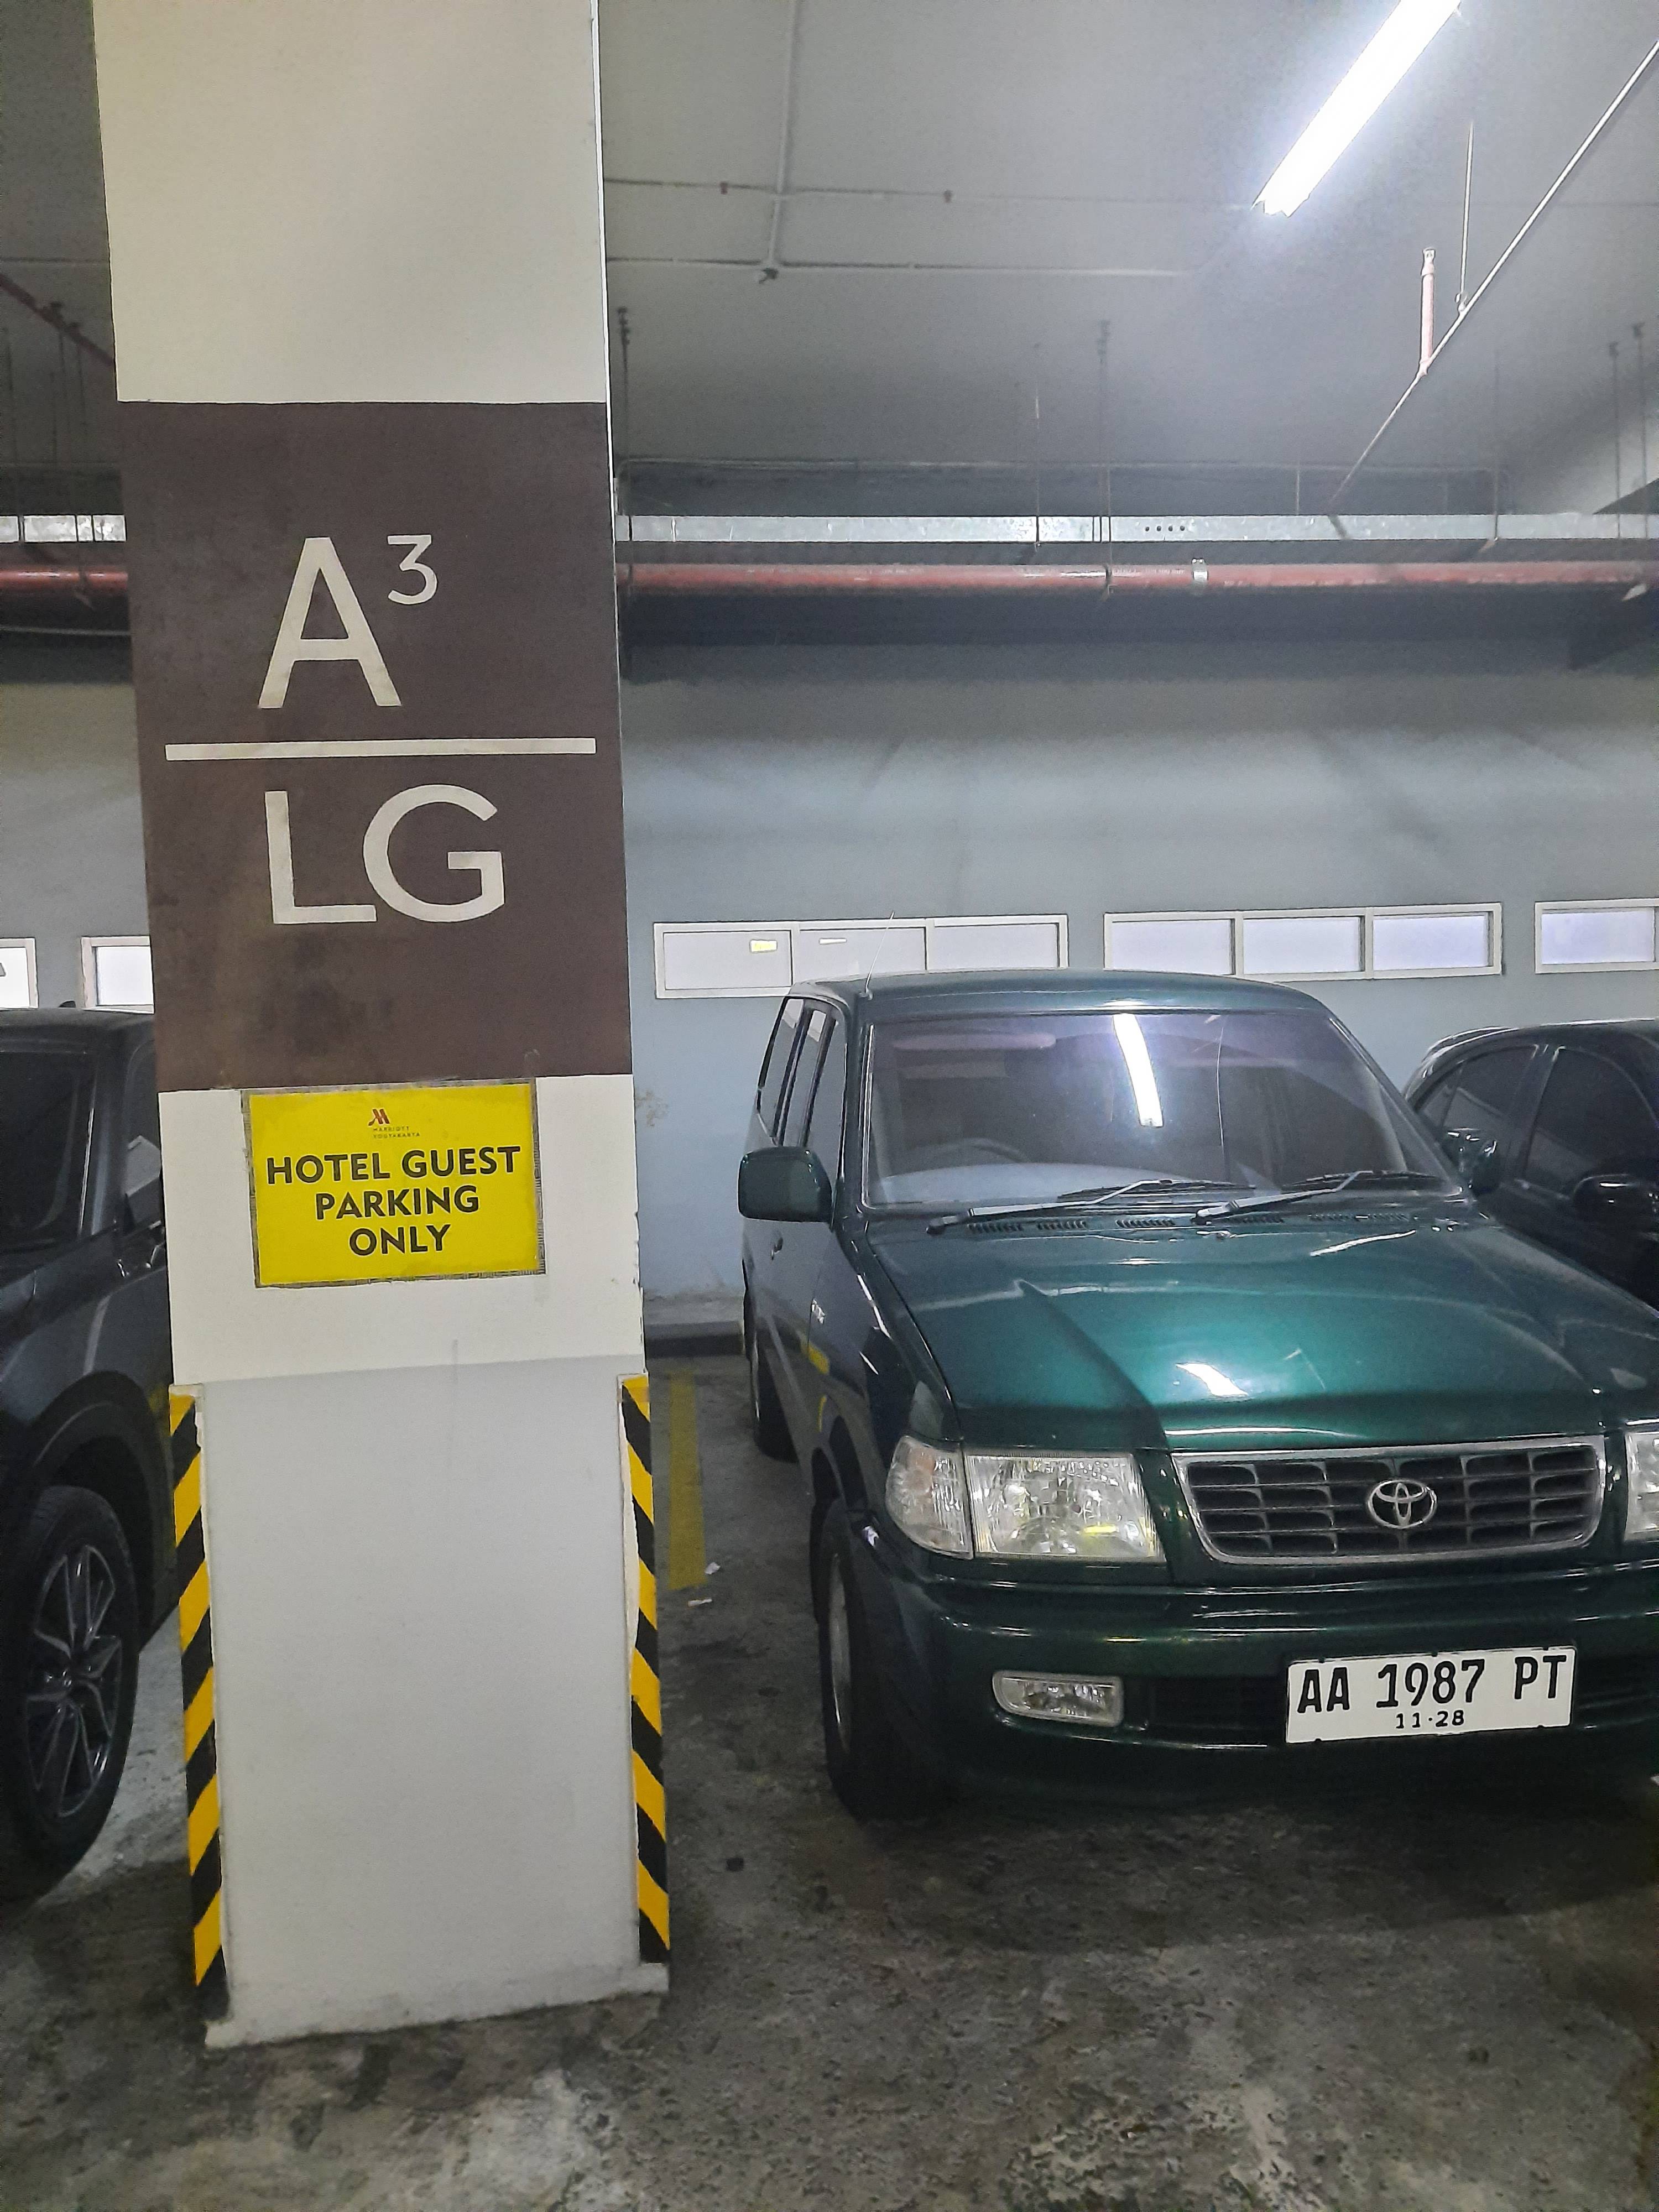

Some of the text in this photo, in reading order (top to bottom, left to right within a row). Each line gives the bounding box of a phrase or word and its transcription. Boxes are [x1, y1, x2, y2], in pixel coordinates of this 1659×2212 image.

[265, 784, 505, 924] LG
[267, 1146, 521, 1185] HOTEL GUEST
[315, 1185, 479, 1220] PARKING
[349, 1224, 451, 1256] ONLY
[1297, 1655, 1567, 1714] AA 1987 PT
